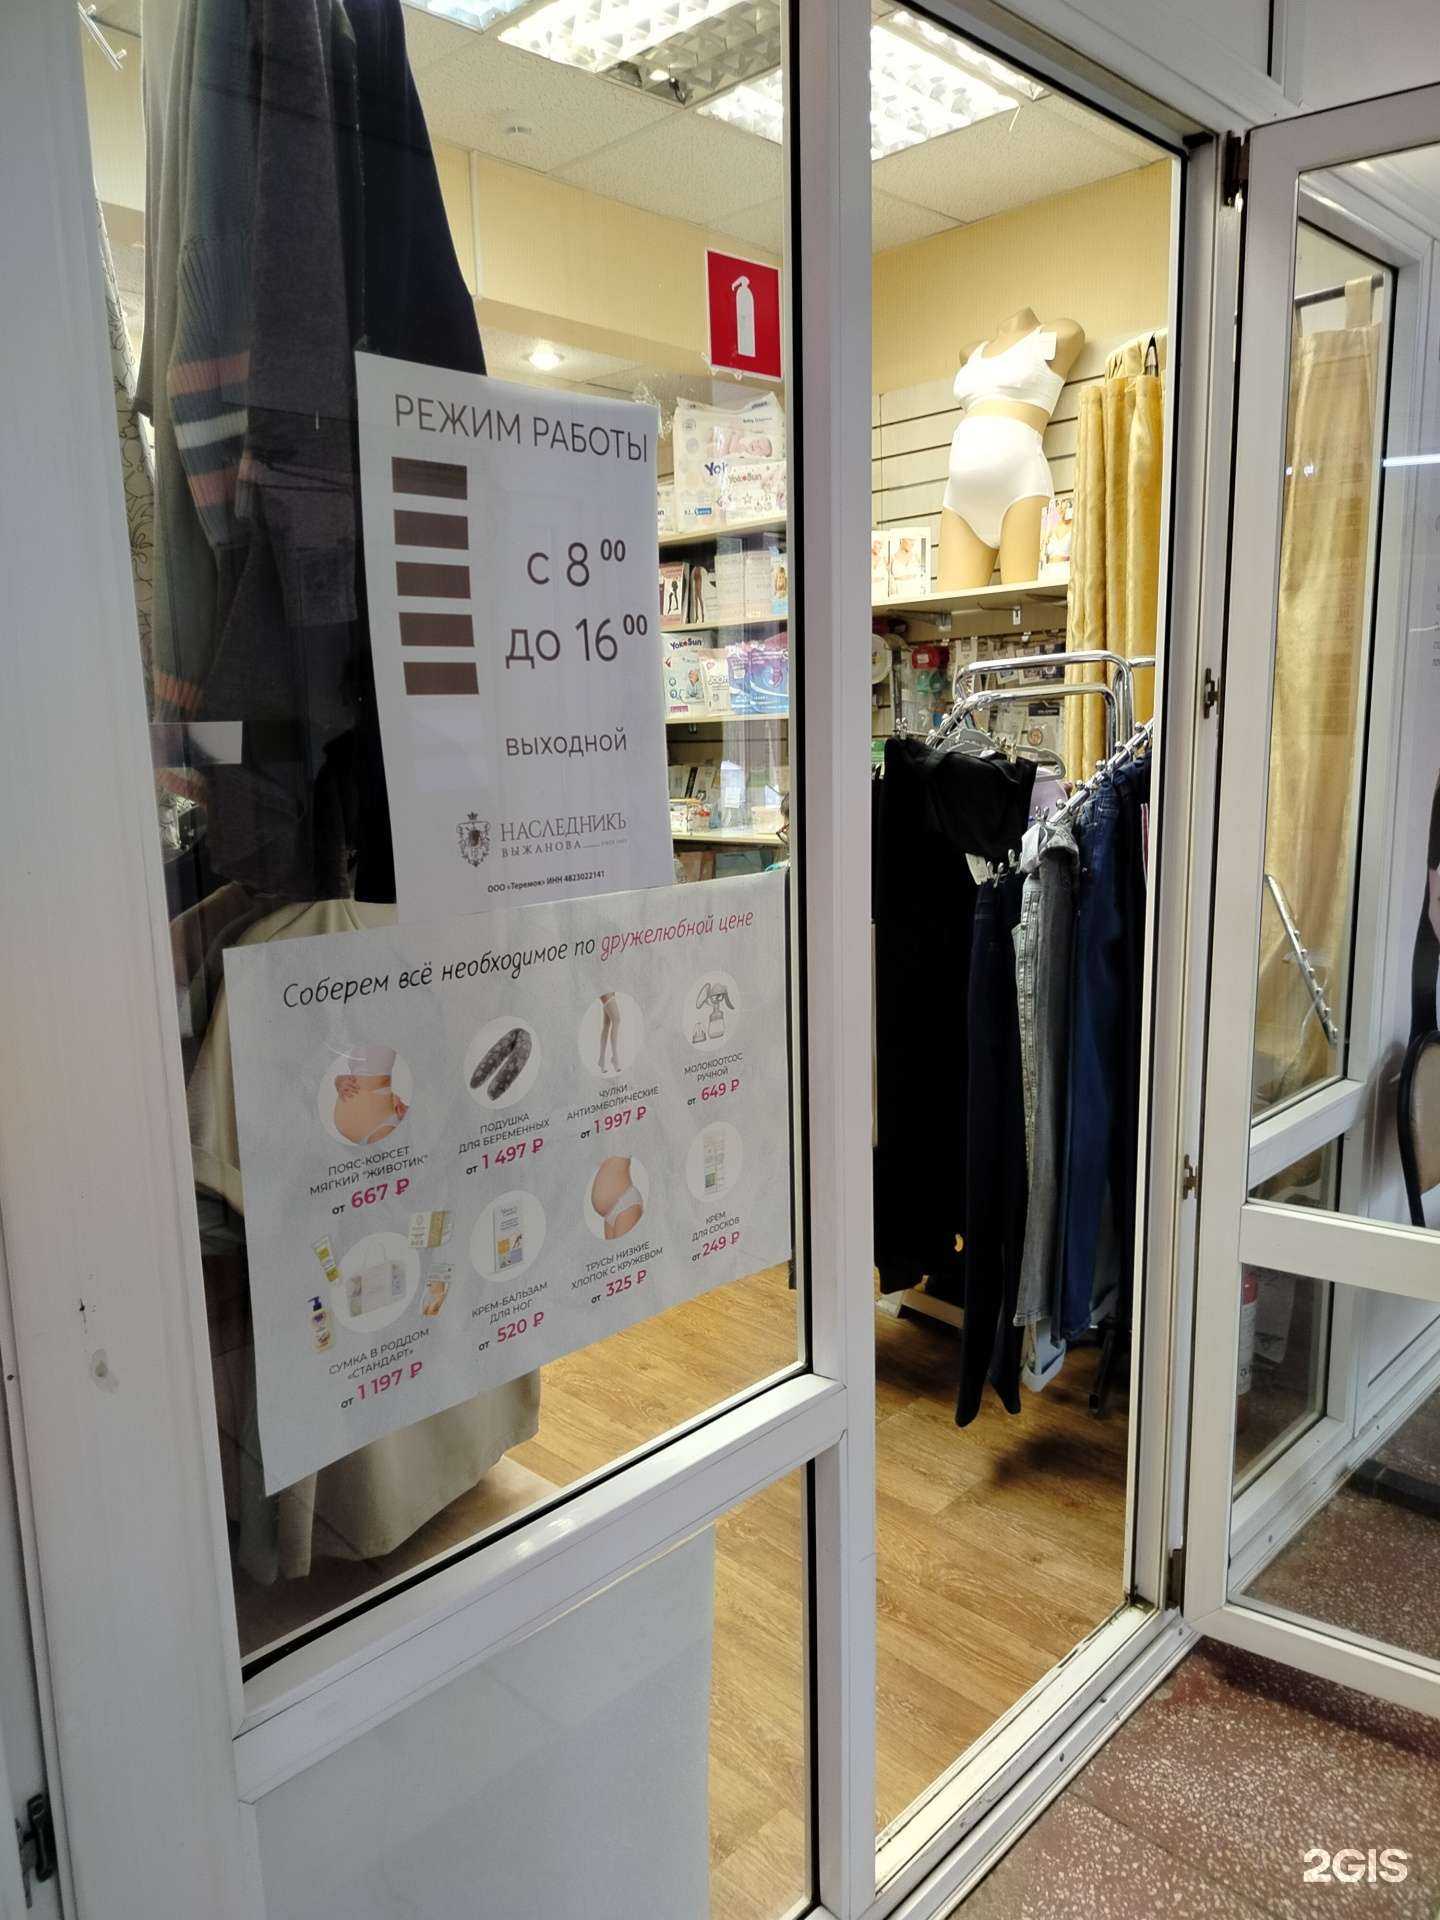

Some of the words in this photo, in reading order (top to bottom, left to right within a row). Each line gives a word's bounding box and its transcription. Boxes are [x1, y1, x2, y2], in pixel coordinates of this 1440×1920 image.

[395, 394, 521, 444] РЕЖИМ
[534, 417, 647, 462] РАБОТЫ
[501, 812, 626, 842] НАСЛЕДНИКЪ
[502, 840, 581, 857] ВЫЖАНОВА
[488, 884, 505, 893] ООО
[547, 876, 563, 885] ИНН
[283, 974, 389, 1008] Соберем
[399, 961, 432, 989] всё
[441, 943, 567, 982] необходимое
[574, 939, 595, 956] по
[600, 914, 714, 961] дружелюбной
[719, 911, 753, 933] цене
[684, 1053, 743, 1074] МОЛОКООТСОС
[697, 1066, 728, 1081] РУЧНОЙ
[567, 1086, 659, 1120] АНТИЭМБОЛИЧЕСКИЕ
[599, 1083, 628, 1098] ЧУЛКИ
[687, 1097, 696, 1105] от
[701, 1083, 726, 1101] 649
[480, 1113, 530, 1134] ПОДУШКА
[580, 1130, 591, 1139] от
[458, 1139, 481, 1154] ДЛЯ
[483, 1119, 550, 1146] БЕРЕМЕННЫХ
[328, 1146, 410, 1176] ПОЯС-КОРСЕТ
[466, 1165, 478, 1175] от
[310, 1170, 360, 1195] МЯГКИЙ
[332, 1204, 345, 1215] от
[351, 1184, 388, 1208] 667
[692, 1229, 708, 1242] ДЛЯ
[709, 1217, 740, 1236] СОСКОВ
[705, 1211, 726, 1225] КРЕМ
[586, 1257, 614, 1272] ТРУСЫ
[616, 1241, 650, 1260] НИЗКИЕ
[692, 1253, 701, 1262] от
[703, 1237, 726, 1257] 249
[571, 1269, 608, 1290] ХЛОПОК
[617, 1248, 663, 1272] КРУЖЕВОМ
[472, 1281, 548, 1318] КРЕМ-БАЛЬЗАМ
[591, 1295, 601, 1304] от
[606, 1276, 632, 1297] 325
[490, 1309, 510, 1325] ДЛЯ
[512, 1300, 532, 1315] НОГ
[478, 1341, 489, 1351] от
[497, 1319, 526, 1343] 520
[329, 1352, 367, 1375] СУМКА
[370, 1345, 378, 1358] В
[380, 1328, 429, 1354] РОДДОМ
[341, 1398, 353, 1409] от
